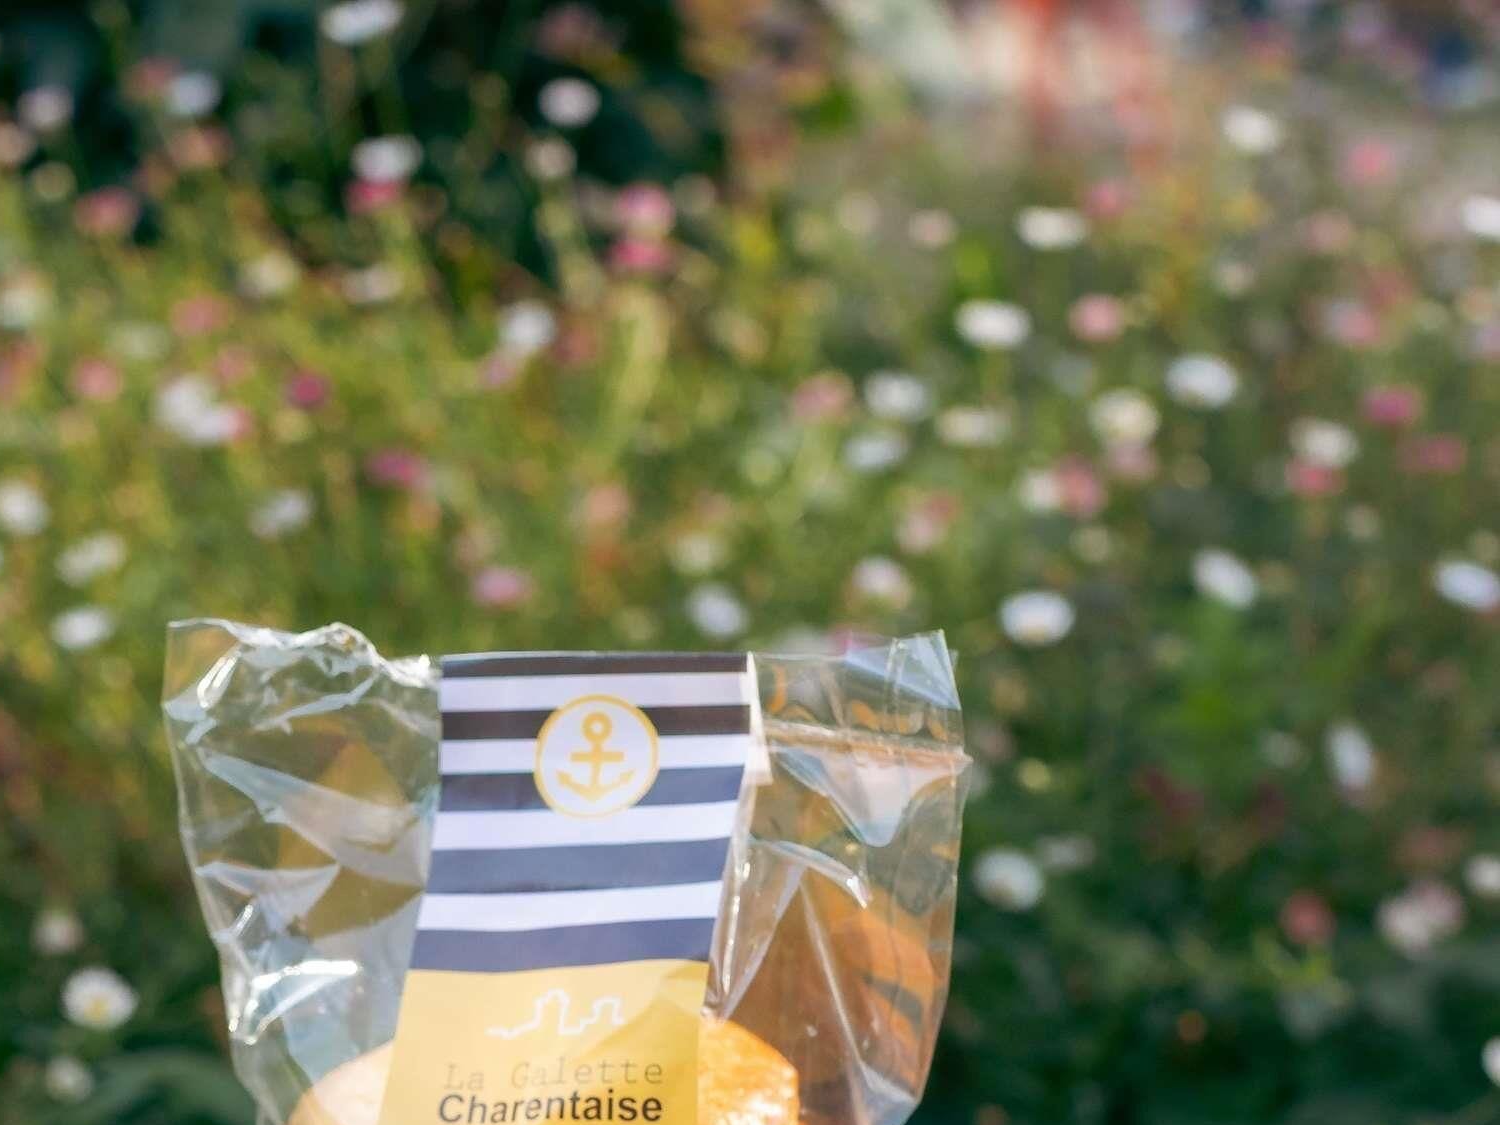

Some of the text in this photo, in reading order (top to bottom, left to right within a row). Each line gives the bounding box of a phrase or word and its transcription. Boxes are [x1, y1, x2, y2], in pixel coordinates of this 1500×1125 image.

[444, 1056, 663, 1091] La Galette
[438, 1088, 664, 1124] Charentaise
